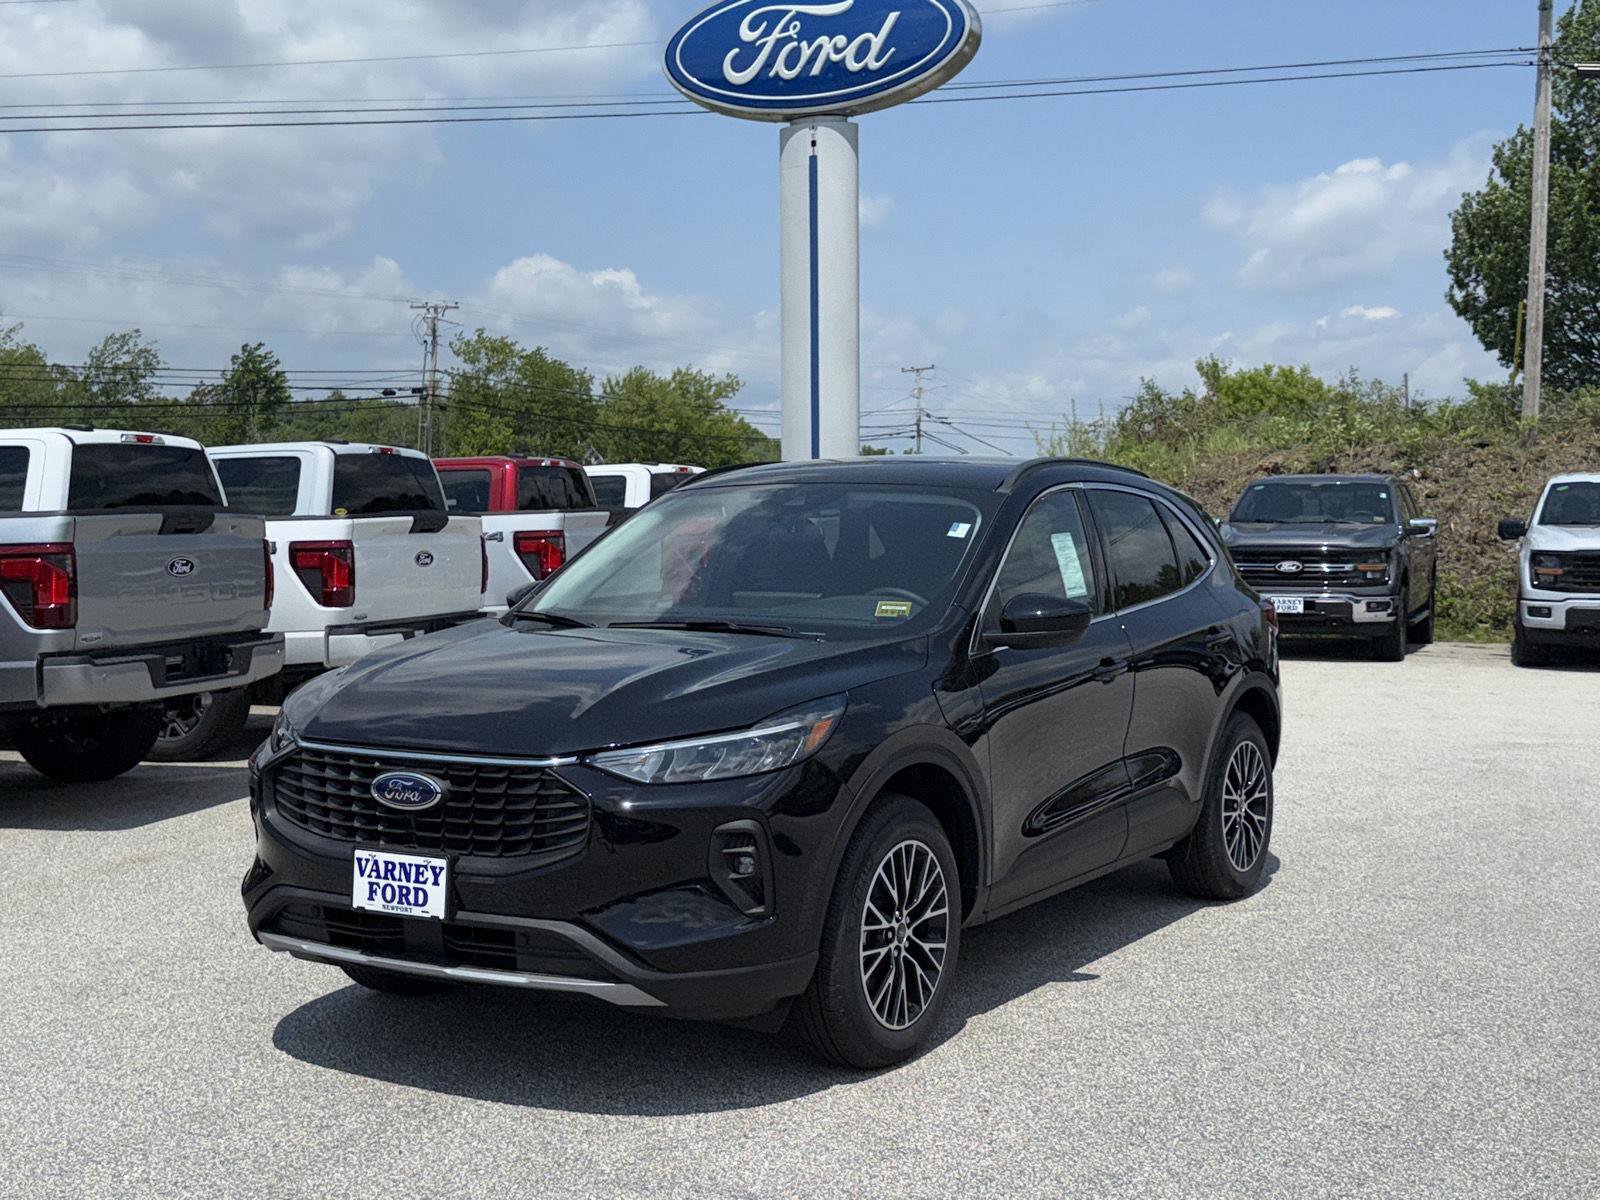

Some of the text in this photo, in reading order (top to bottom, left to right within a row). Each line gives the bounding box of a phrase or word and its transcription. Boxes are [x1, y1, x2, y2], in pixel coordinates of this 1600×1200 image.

[723, 0, 900, 85] Ford
[173, 560, 191, 573] Ford
[385, 779, 422, 801] Ford
[356, 857, 445, 886] VARNEY
[367, 881, 429, 907] FORD
[382, 904, 413, 913] NEWPORT
